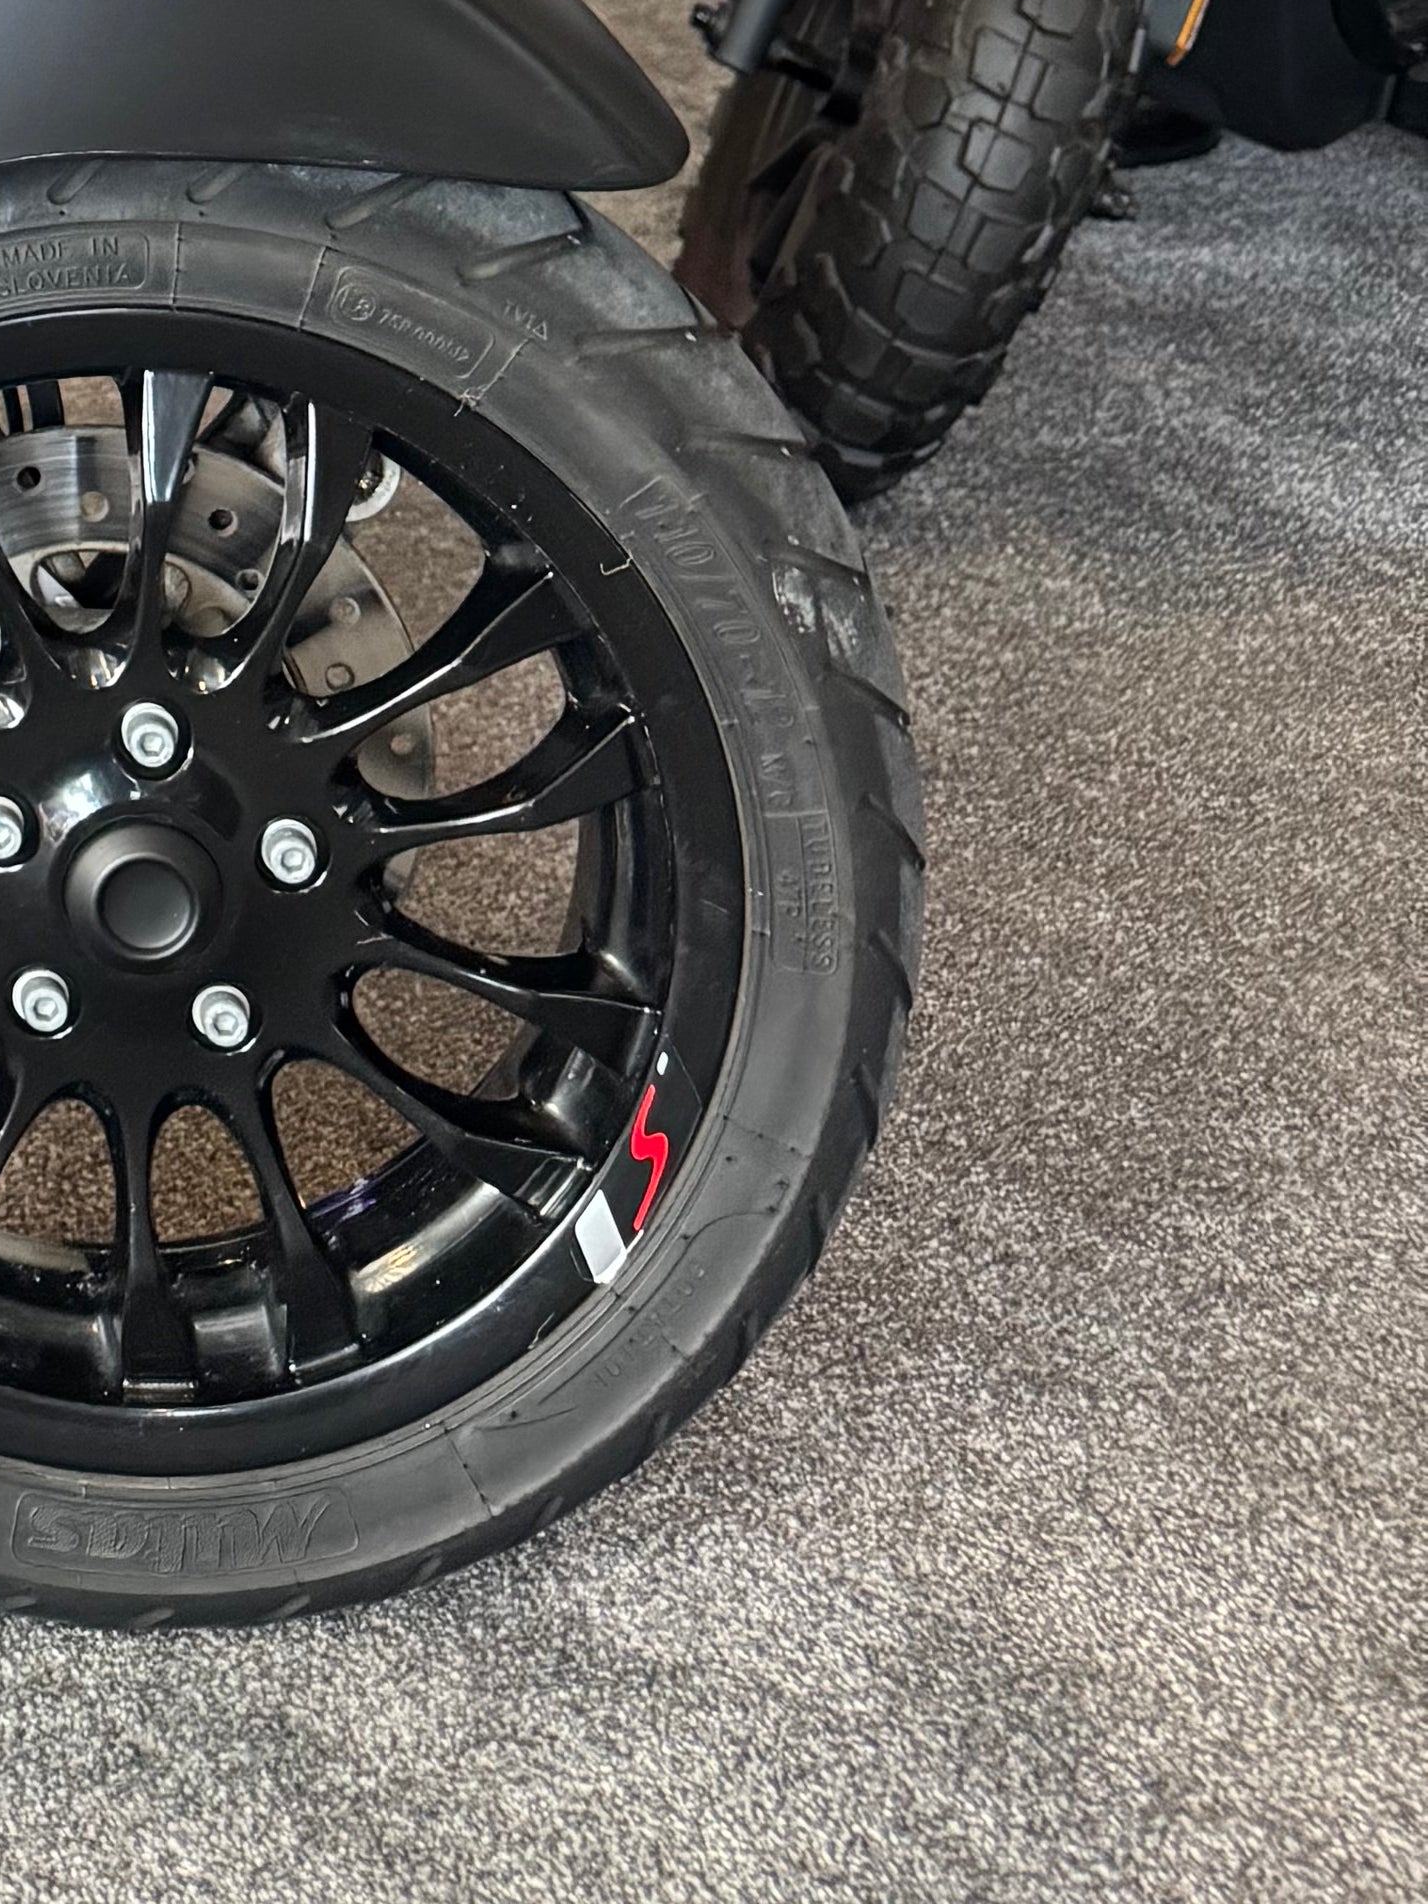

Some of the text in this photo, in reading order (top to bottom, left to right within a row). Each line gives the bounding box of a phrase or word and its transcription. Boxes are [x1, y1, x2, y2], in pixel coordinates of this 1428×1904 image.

[1, 235, 120, 268] MADE IN
[801, 814, 835, 969] TUBELESS
[27, 1493, 332, 1574] Mitas
